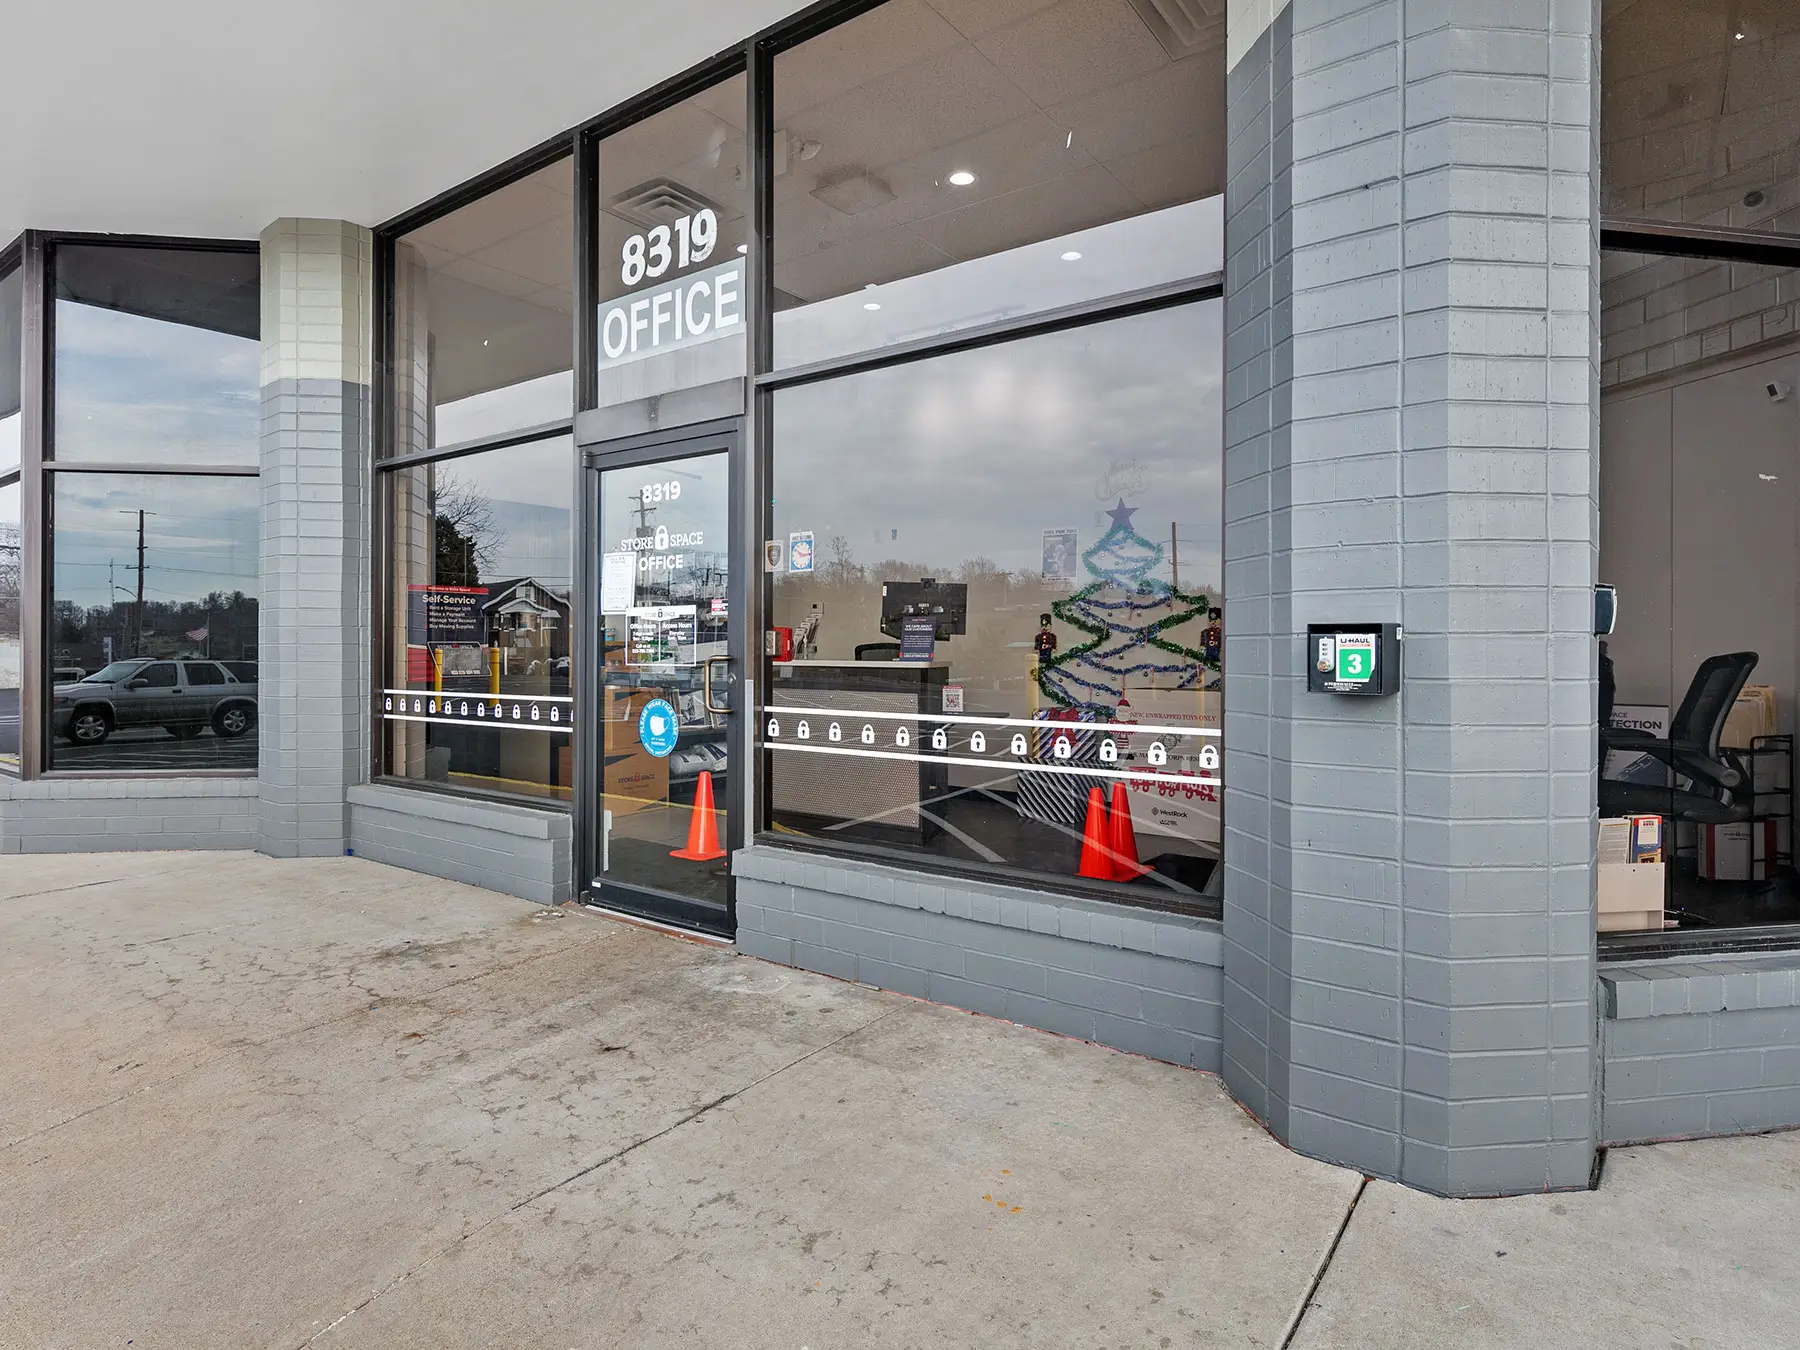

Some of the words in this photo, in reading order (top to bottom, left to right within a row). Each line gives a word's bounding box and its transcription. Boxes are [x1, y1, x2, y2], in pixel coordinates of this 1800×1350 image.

[621, 209, 717, 286] 8319
[603, 270, 739, 358] OFFICE
[642, 481, 681, 503] 8319
[621, 536, 654, 552] STORE
[670, 532, 703, 547] SPACE
[639, 554, 683, 571] OFFICE
[422, 594, 476, 605] Self-Service
[1347, 653, 1362, 675] 3
[640, 707, 649, 734] PLEASE
[647, 700, 661, 709] WEAR
[661, 701, 673, 714] FACE
[1130, 711, 1144, 719] NEW,
[1145, 712, 1181, 720] UNWRAPPED
[1160, 809, 1188, 818] WestRock
